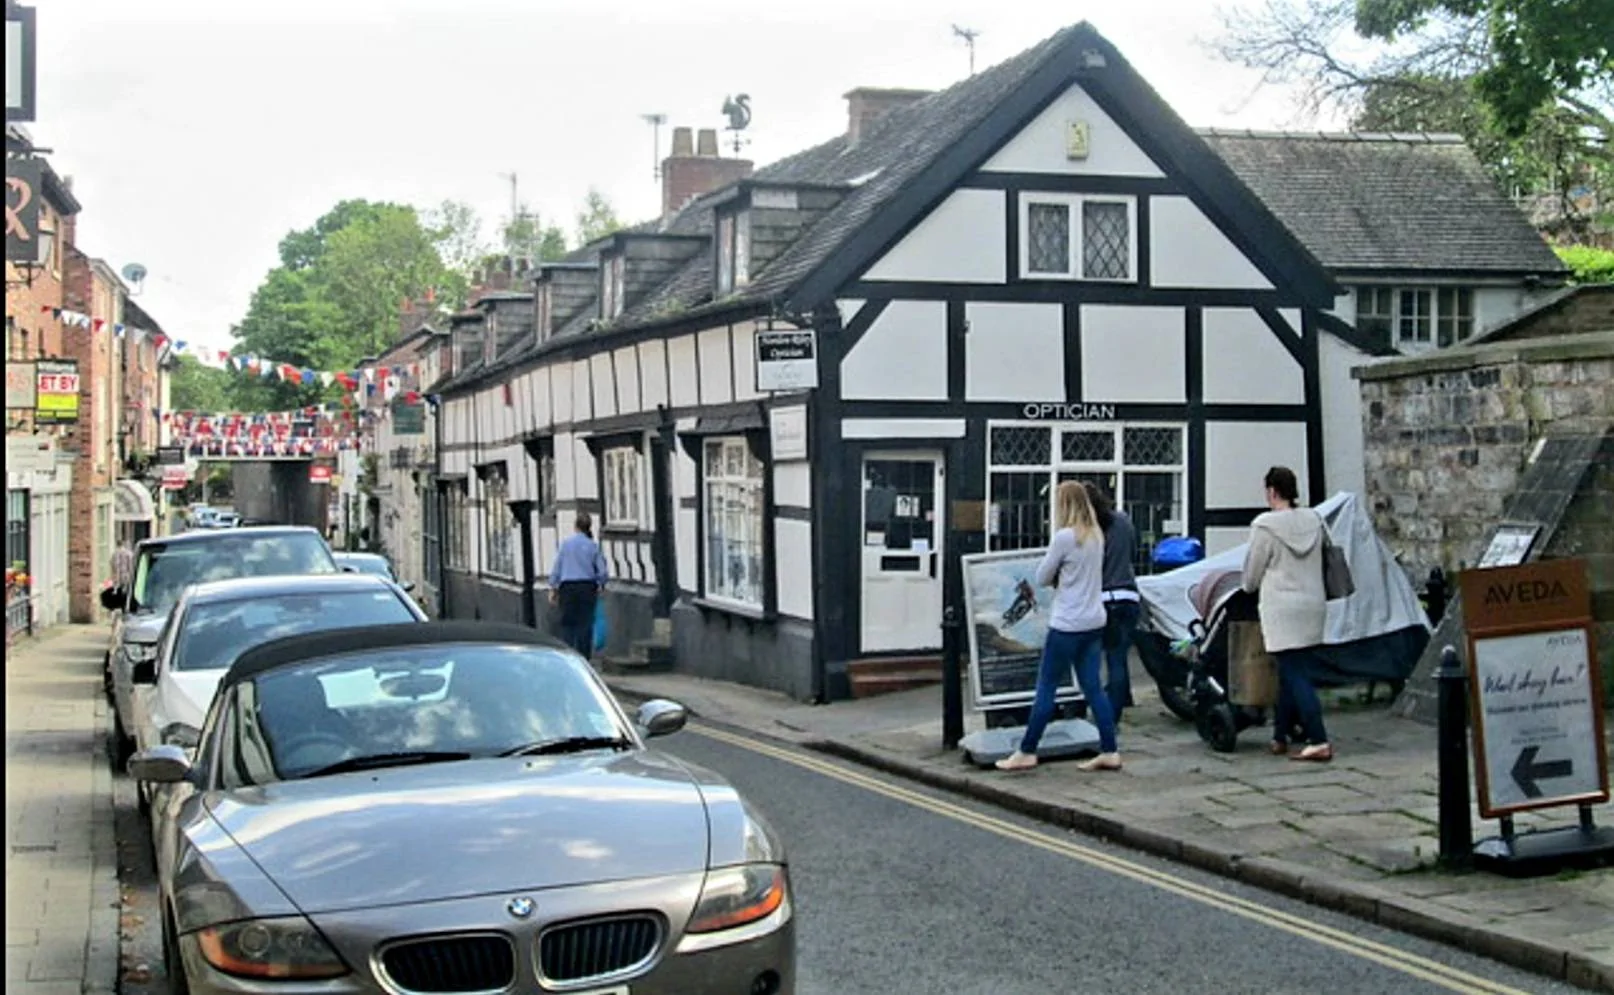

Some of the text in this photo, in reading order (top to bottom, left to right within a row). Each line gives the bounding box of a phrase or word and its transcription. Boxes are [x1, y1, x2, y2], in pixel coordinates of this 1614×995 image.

[38, 375, 57, 391] ET
[60, 375, 77, 390] BY
[1023, 403, 1115, 419] OPTICIAN
[1485, 579, 1570, 604] AVEDA
